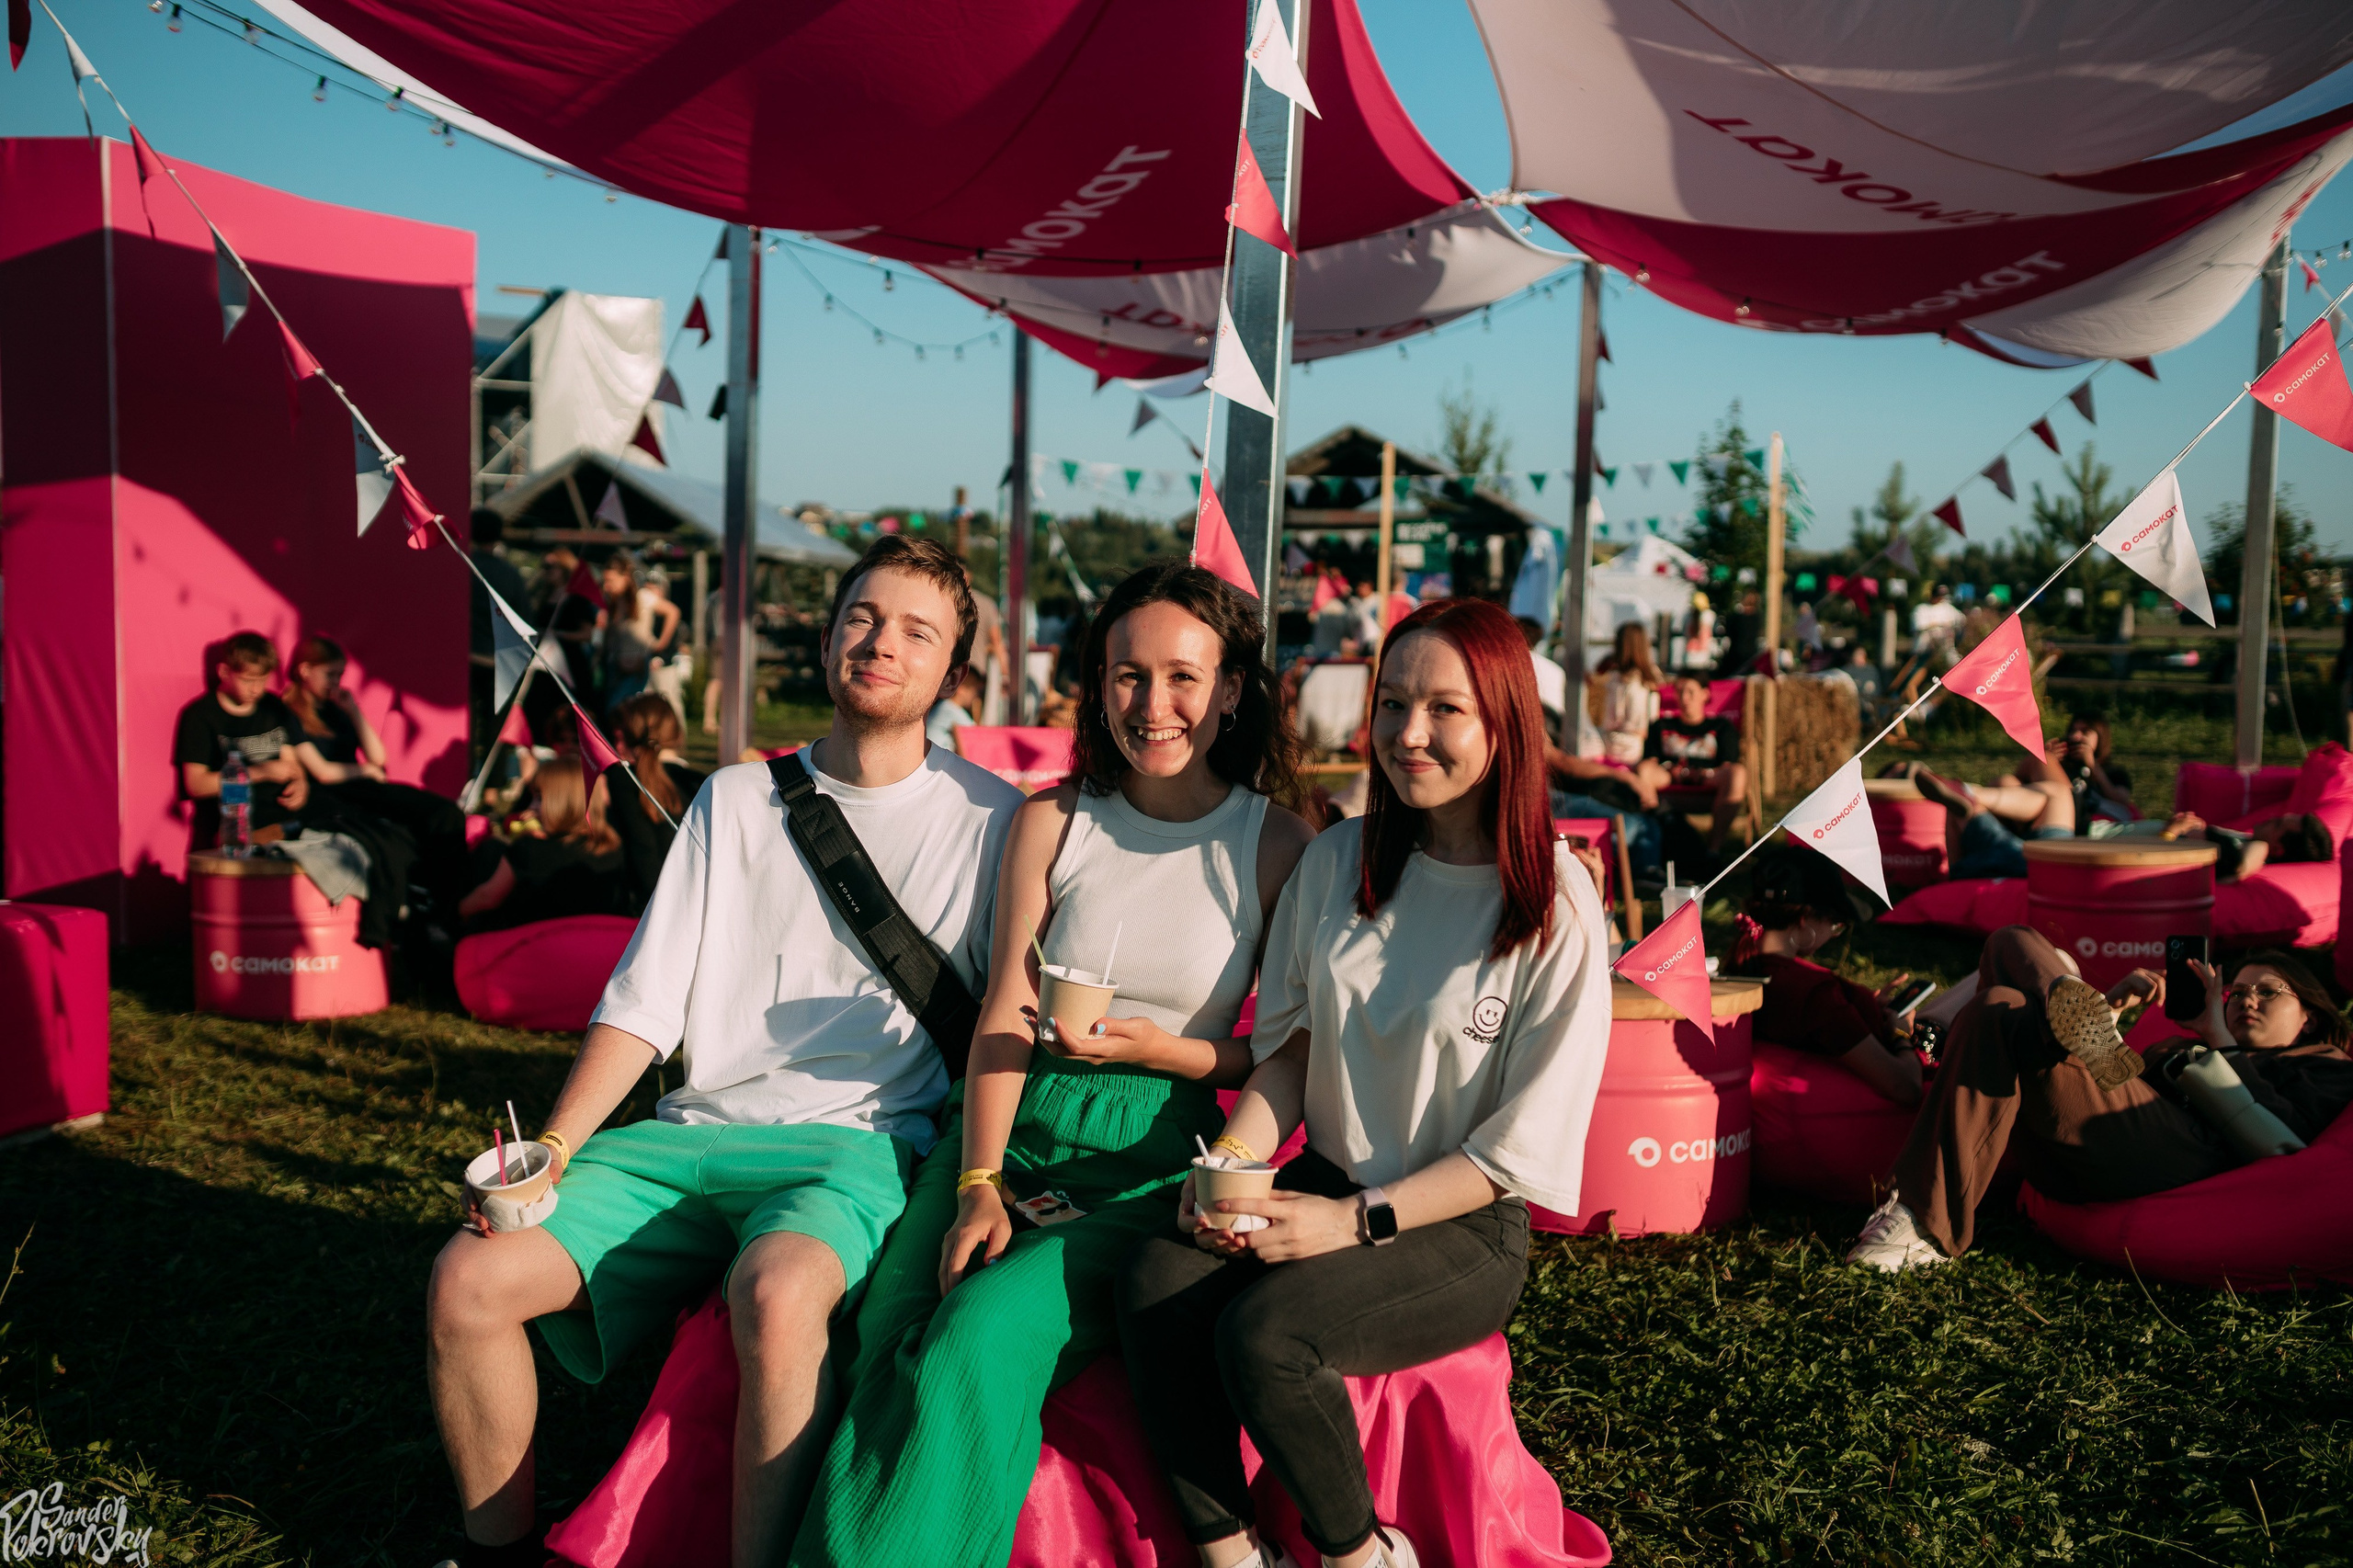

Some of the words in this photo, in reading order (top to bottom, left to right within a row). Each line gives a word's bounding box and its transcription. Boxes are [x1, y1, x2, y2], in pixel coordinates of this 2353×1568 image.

[1682, 108, 2018, 223] амокат
[2285, 352, 2330, 394] самокат
[2131, 504, 2178, 544] самокат
[1985, 647, 2020, 688] самокат
[1824, 791, 1862, 832] самокат
[837, 881, 860, 913] BANGE
[230, 955, 341, 974] самокат
[1656, 935, 1698, 974] самокат
[2101, 940, 2166, 959] само
[1669, 1128, 1751, 1164] самок
